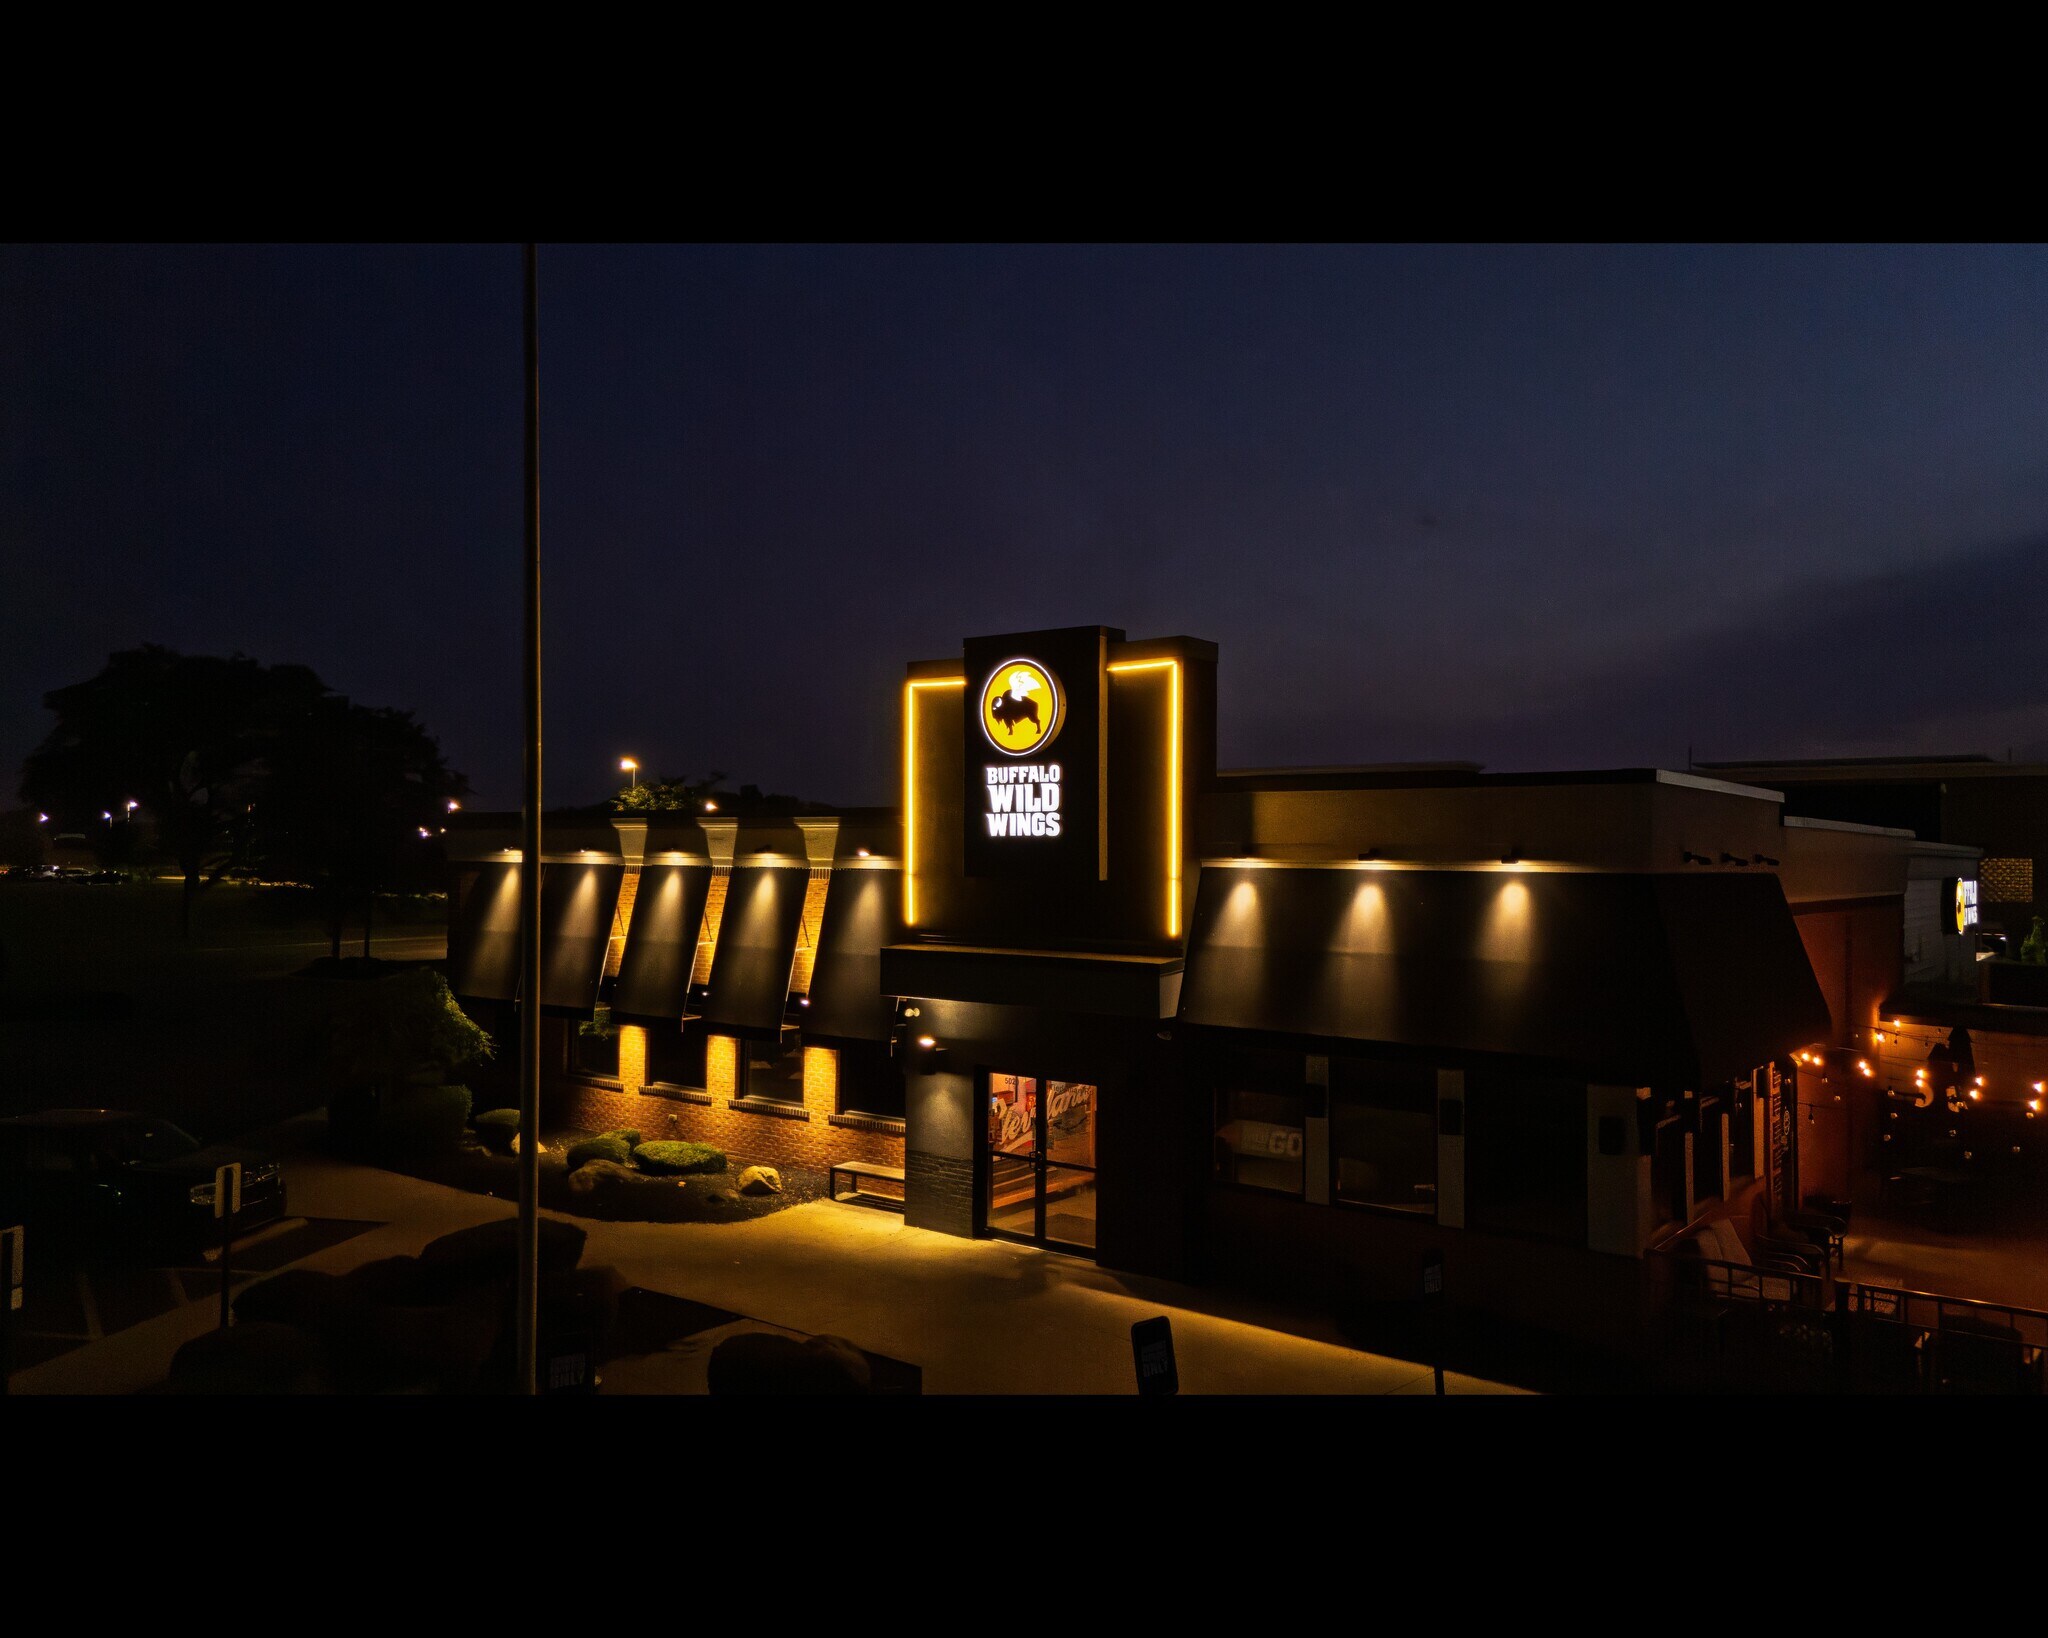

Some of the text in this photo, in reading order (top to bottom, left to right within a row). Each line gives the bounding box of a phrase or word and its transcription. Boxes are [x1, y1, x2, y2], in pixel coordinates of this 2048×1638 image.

[986, 764, 1060, 784] BUFFALO
[986, 783, 1060, 812] WILD
[986, 812, 1061, 837] WINGS
[1268, 1130, 1303, 1157] GO
